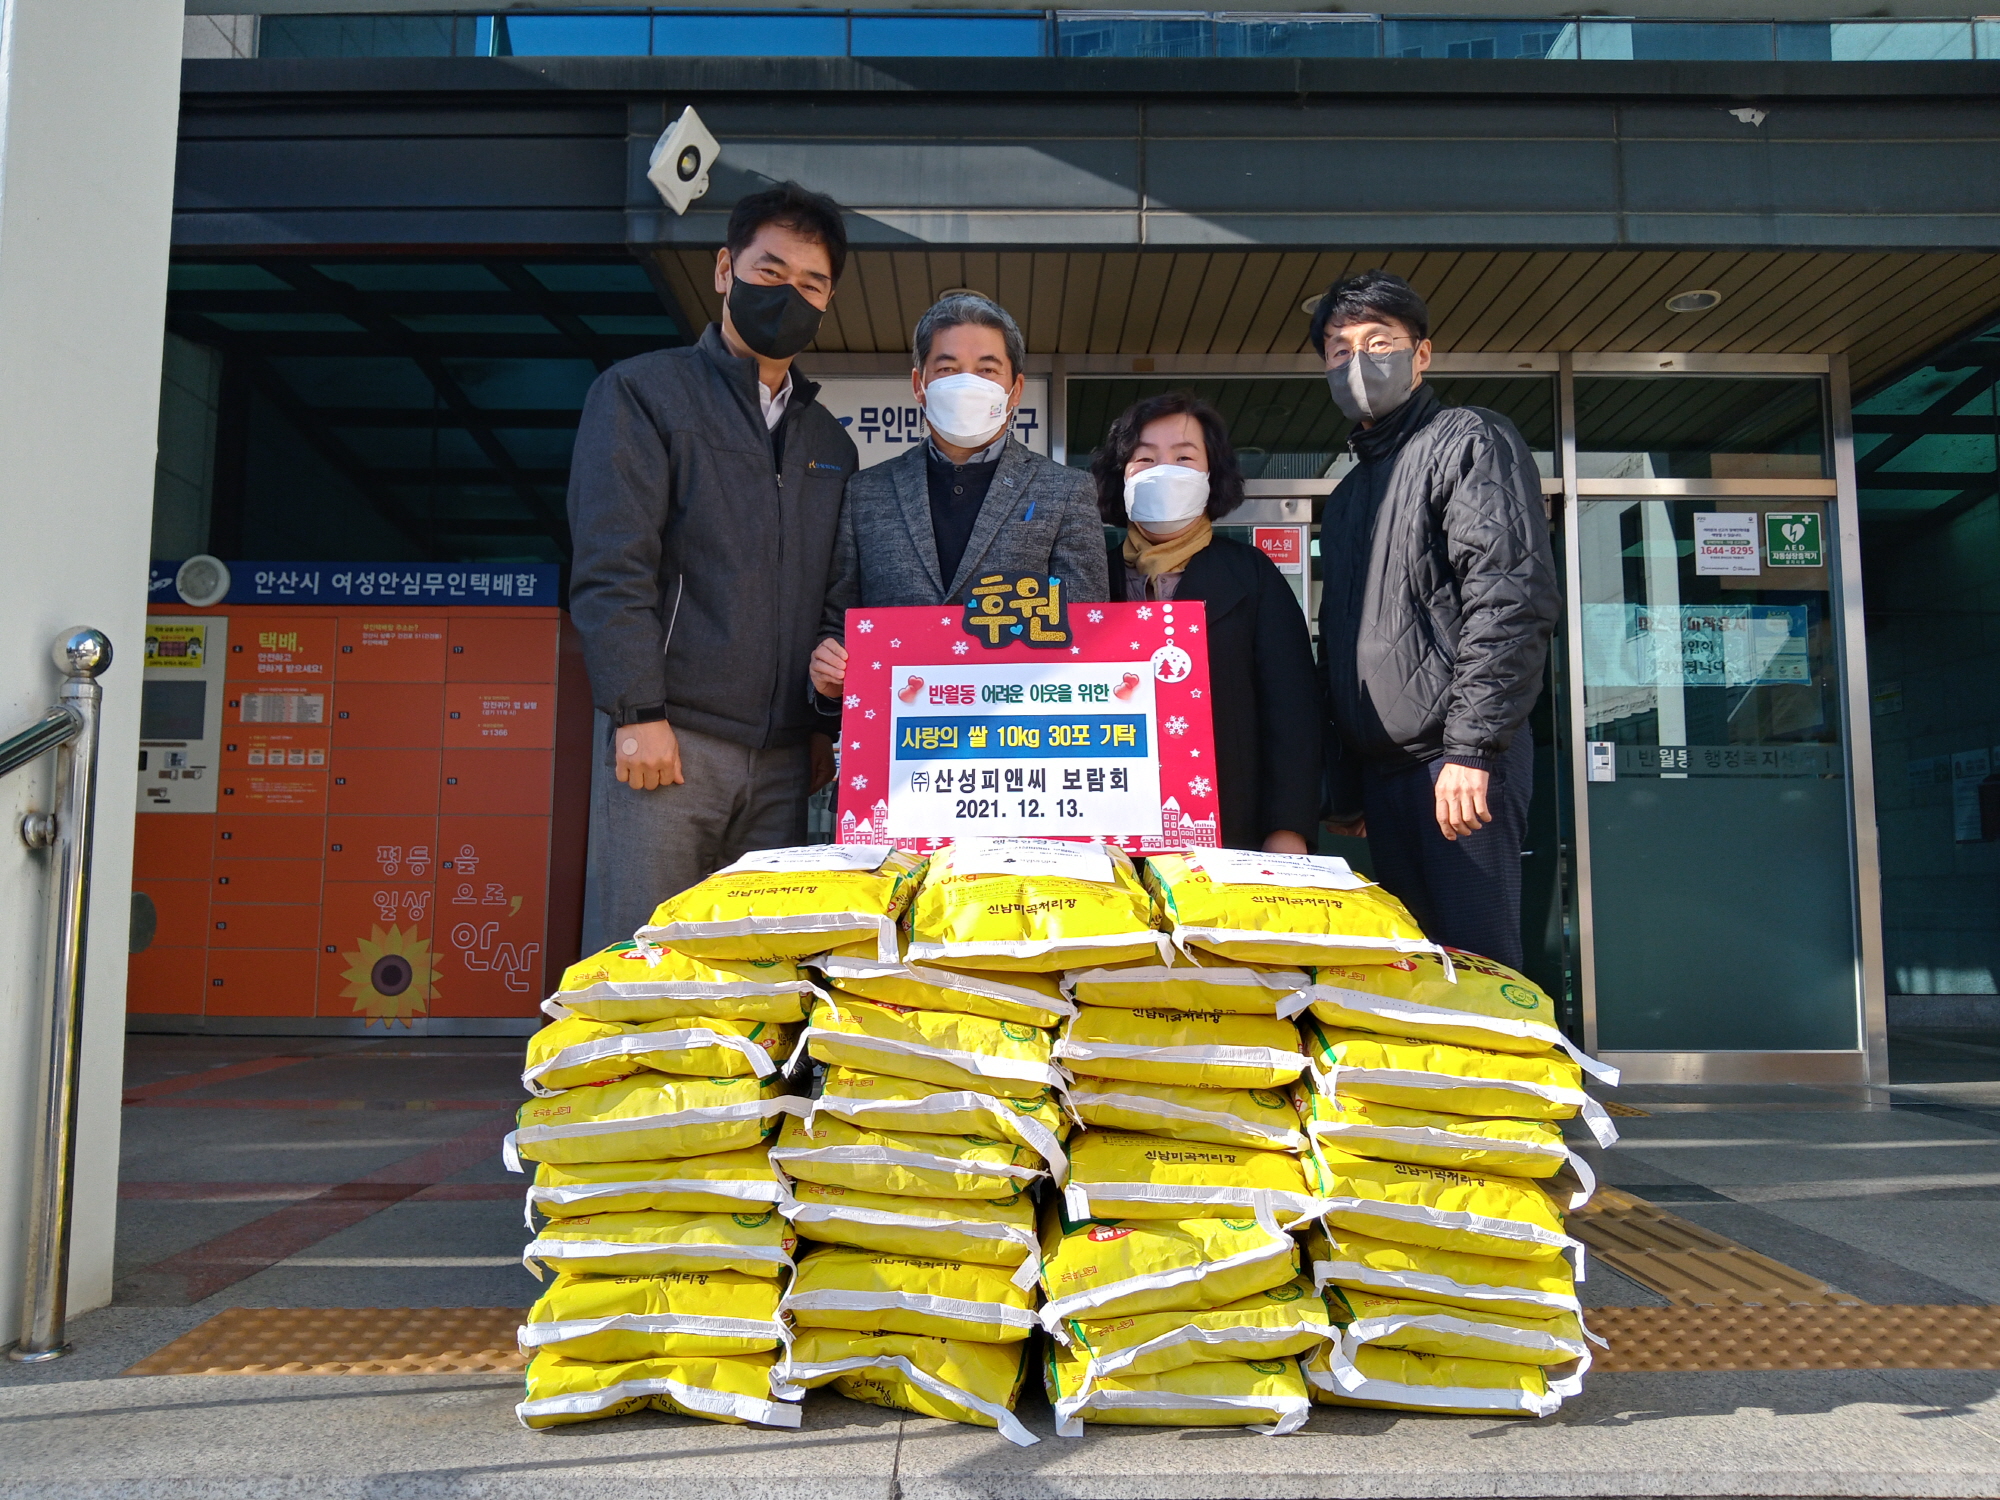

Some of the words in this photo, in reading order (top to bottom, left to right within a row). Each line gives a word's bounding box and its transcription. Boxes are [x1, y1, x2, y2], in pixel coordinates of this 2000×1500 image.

[1261, 539, 1293, 551] 에스원
[1700, 546, 1754, 555] 1644-8295
[255, 570, 320, 596] 안산시
[331, 570, 538, 598] 여성안심무인택배함
[969, 575, 1068, 644] 후원
[259, 632, 304, 654] 택배,
[928, 684, 976, 705] 반월동
[981, 684, 1024, 704] 어려운
[1030, 683, 1073, 704] 이웃을
[1077, 683, 1110, 703] 위한
[901, 726, 958, 750] 사랑의
[967, 726, 988, 749] 쌀
[997, 726, 1040, 749] 10kg
[1048, 725, 1091, 747] 30포
[1100, 724, 1136, 747] 기탁
[1062, 767, 1129, 793] 보람회
[956, 799, 1006, 819] 2021.
[1017, 799, 1045, 819] 12.
[1056, 799, 1084, 818] 13.
[727, 886, 818, 898] 신남미곡처리장
[1251, 895, 1344, 910] 신남미곡처리장
[987, 898, 1077, 915] 신남미곡처리장
[452, 922, 539, 992] 안산
[1144, 1150, 1237, 1164] 신남미곡처리장
